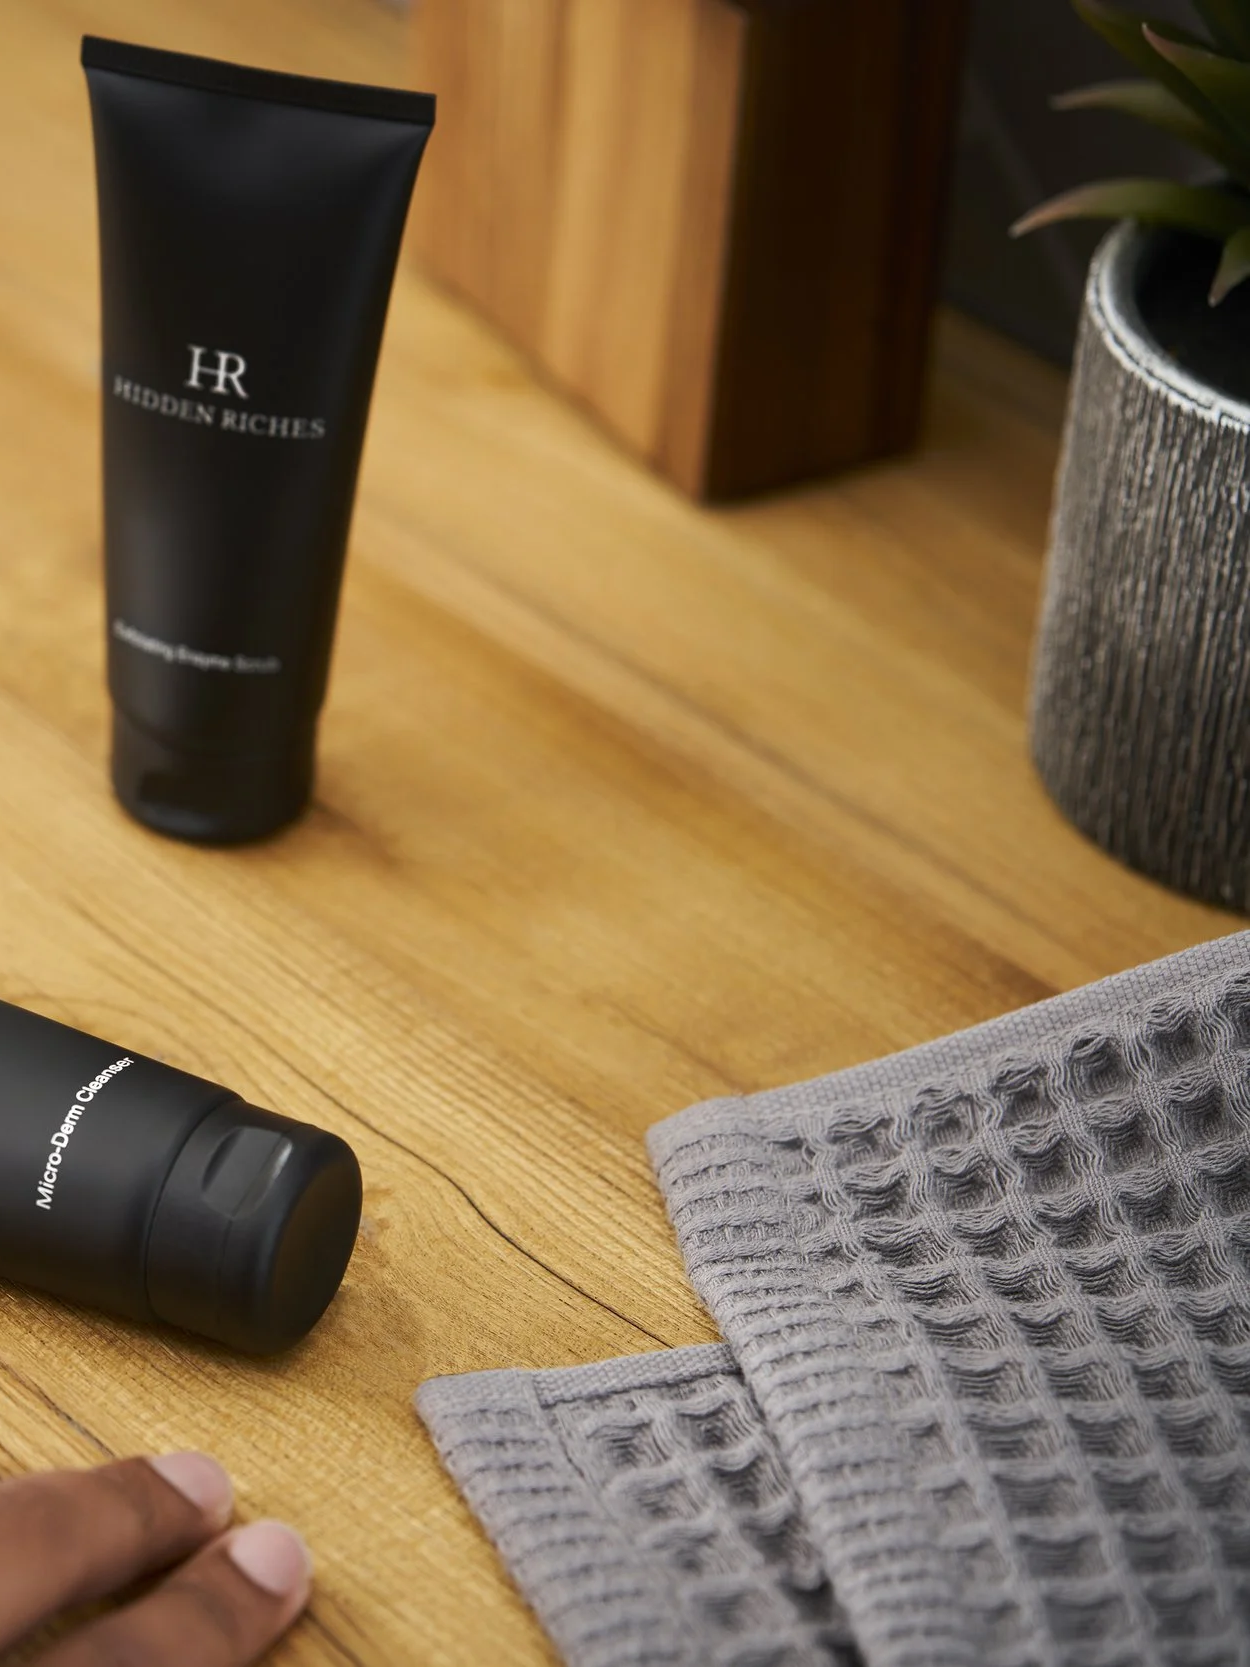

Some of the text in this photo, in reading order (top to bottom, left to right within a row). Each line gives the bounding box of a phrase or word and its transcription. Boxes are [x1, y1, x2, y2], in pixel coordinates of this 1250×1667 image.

[184, 343, 249, 399] HR
[113, 375, 326, 439] HIDDEN RICHES
[35, 1056, 135, 1210] Micro-Derm Cleanser
